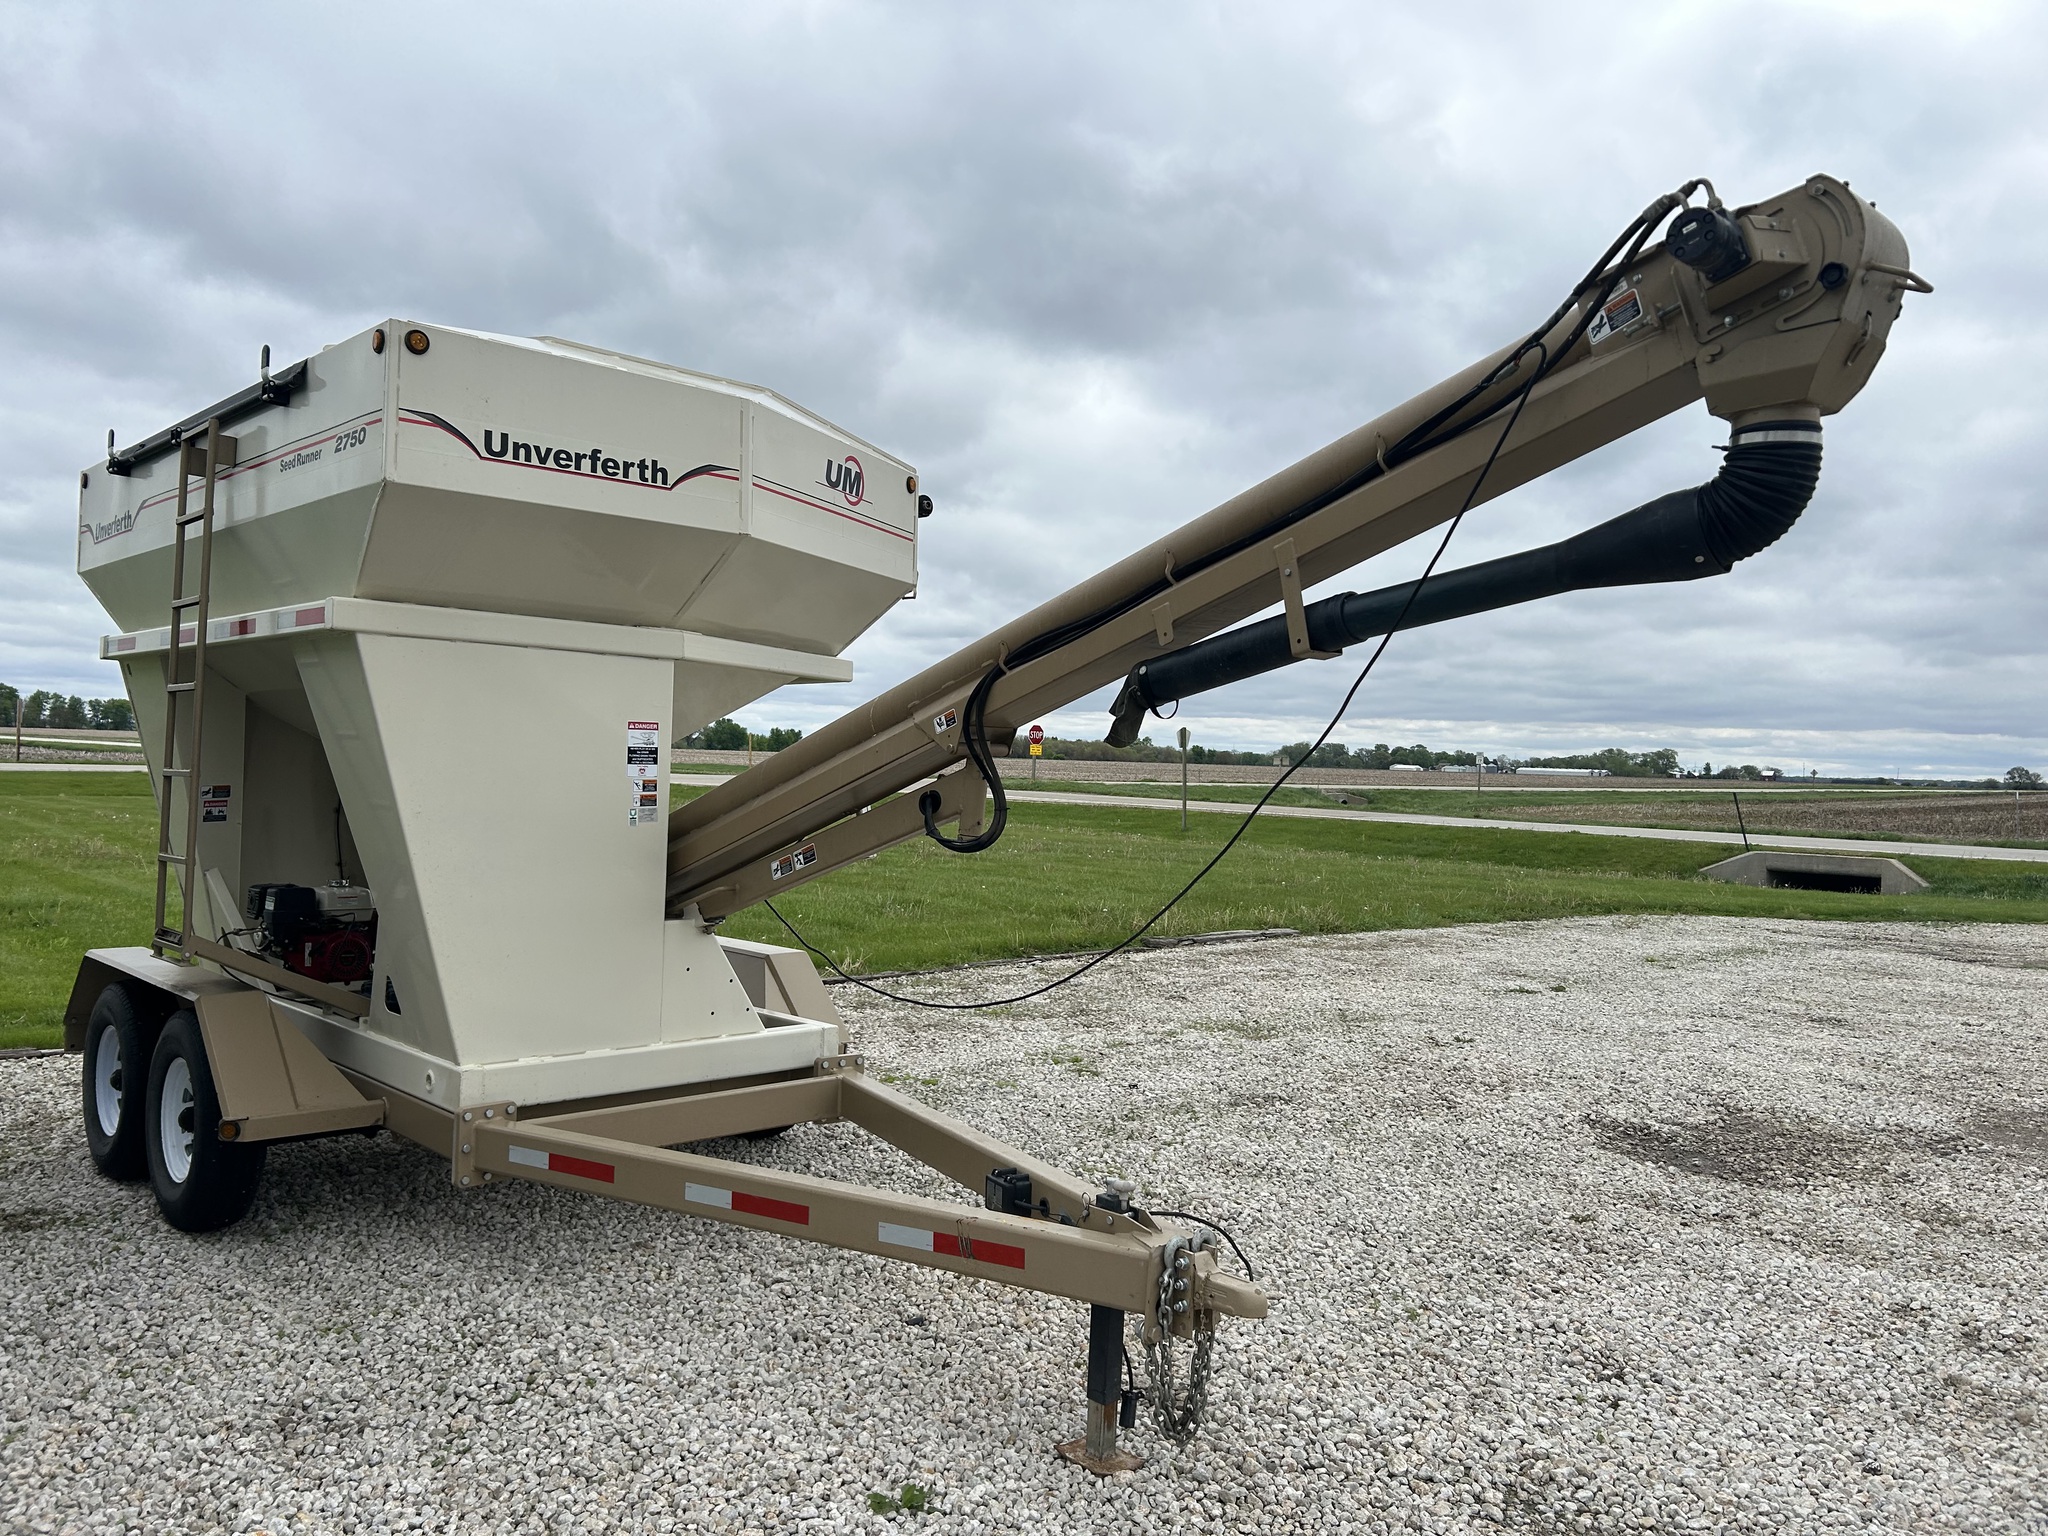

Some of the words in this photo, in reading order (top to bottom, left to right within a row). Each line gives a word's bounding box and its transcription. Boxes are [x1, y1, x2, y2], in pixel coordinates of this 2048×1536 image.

[334, 426, 367, 454] 2750
[483, 429, 669, 486] Unverferth
[825, 458, 862, 497] UM
[95, 510, 132, 541] Unverferth
[1030, 730, 1043, 739] STOP
